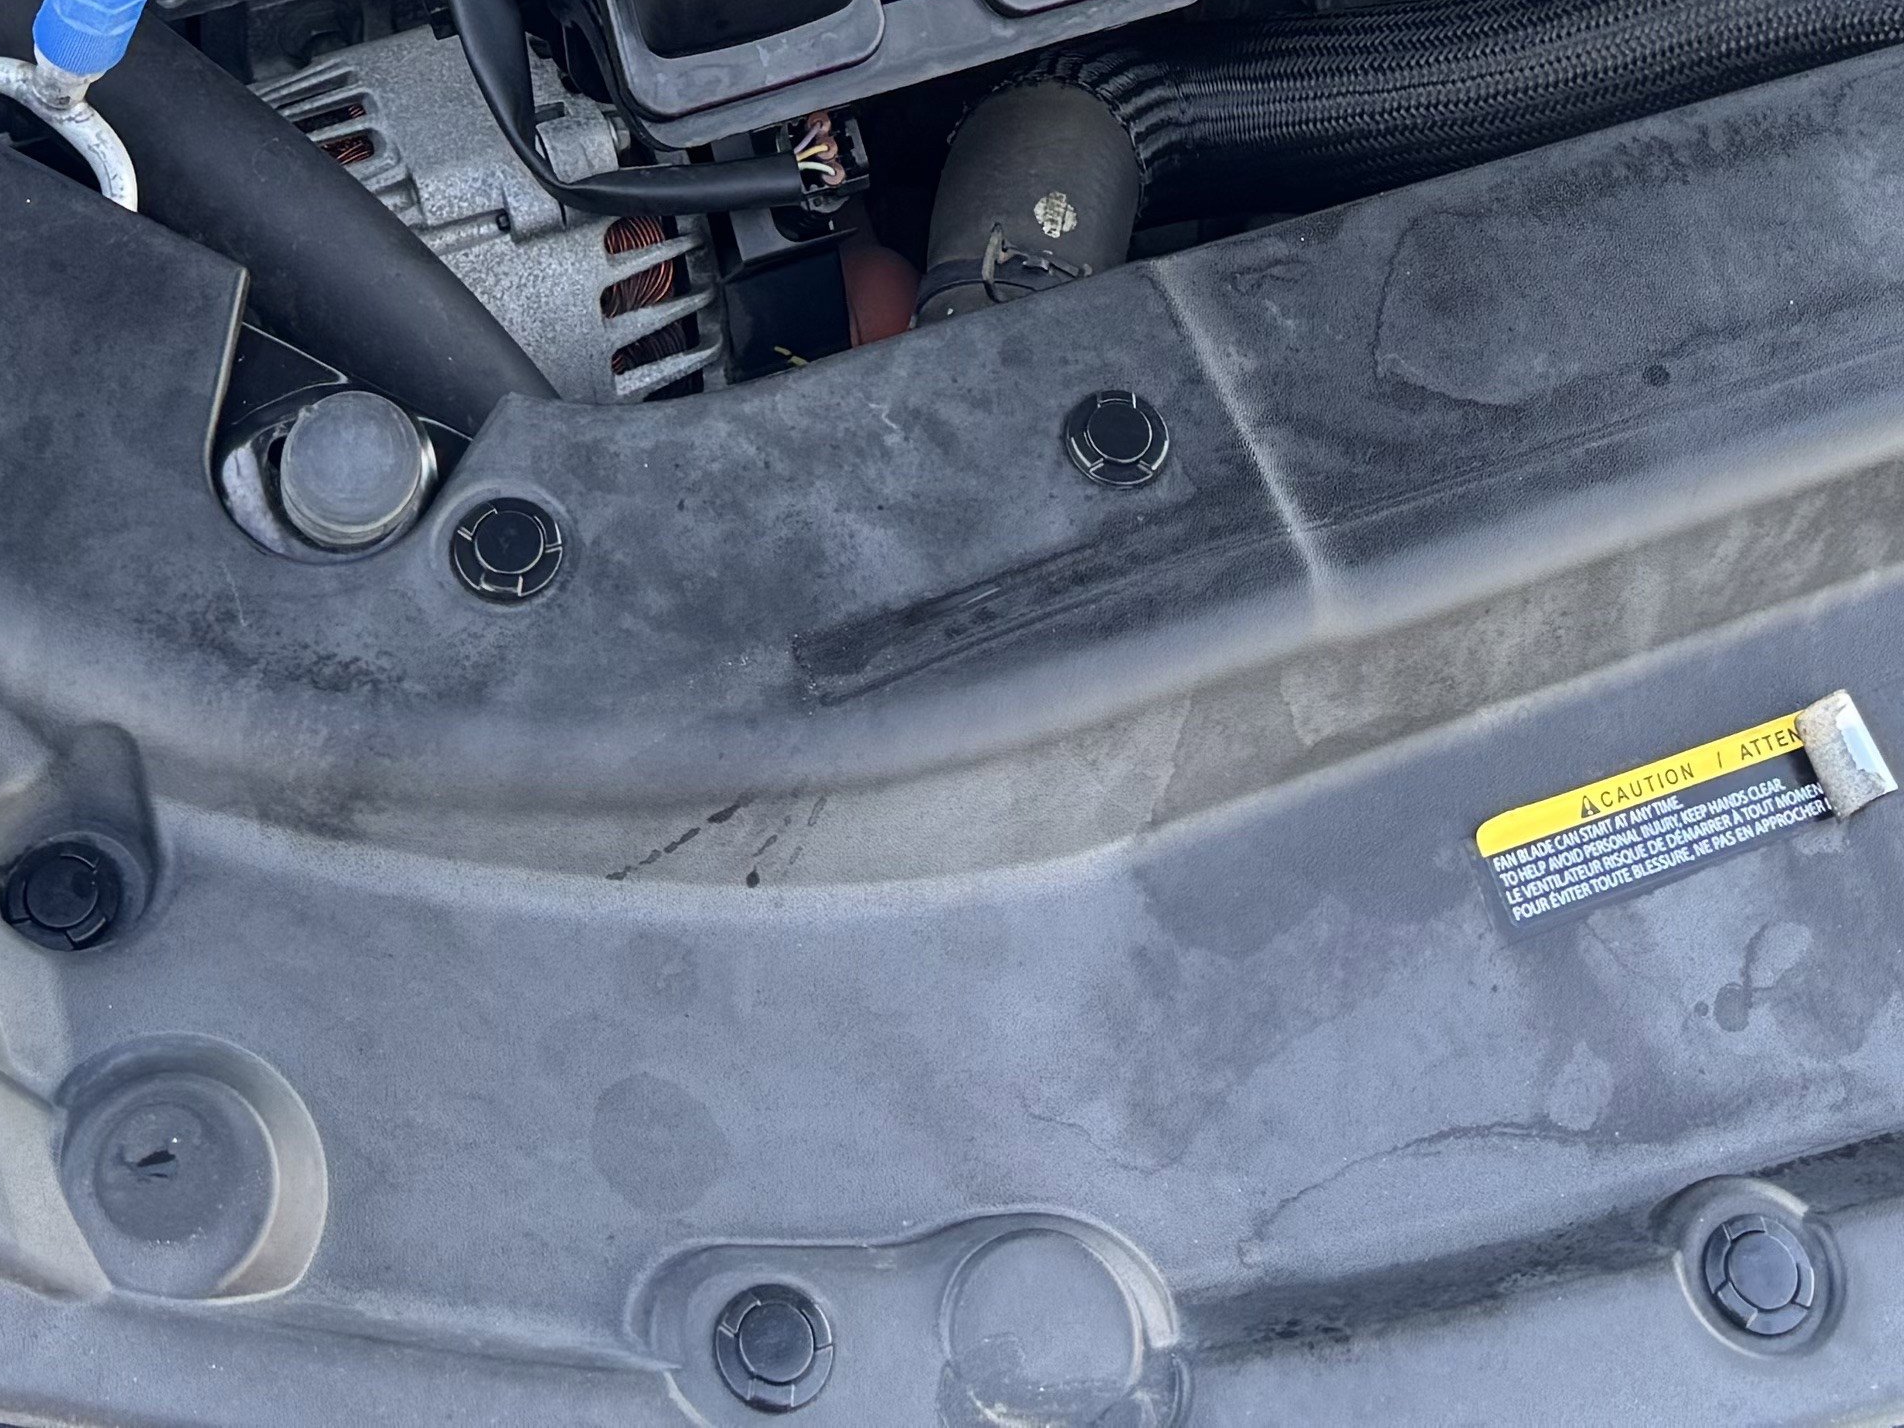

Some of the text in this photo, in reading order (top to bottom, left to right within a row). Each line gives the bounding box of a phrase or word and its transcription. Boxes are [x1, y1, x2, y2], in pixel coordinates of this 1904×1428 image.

[1600, 762, 1695, 808] CAUTION
[1493, 852, 1518, 872] FAN
[1517, 839, 1556, 866] BLADE
[1554, 831, 1582, 850] CAN
[1580, 818, 1615, 844] START
[1614, 812, 1629, 831] AT
[1630, 804, 1656, 826] ANY
[1499, 868, 1520, 888] TO
[1518, 860, 1547, 882] HELP
[1548, 847, 1585, 872] AVOID
[1583, 830, 1643, 860] PERSONAL
[1680, 804, 1708, 825] KEEP
[1707, 789, 1750, 815] HANDS
[1505, 888, 1523, 905] LE
[1521, 859, 1605, 898] VENTILATEUR
[1602, 844, 1649, 870] RISQUE
[1648, 837, 1669, 855] DE
[1666, 814, 1734, 850] DÉMARRER
[1741, 798, 1777, 821] TOUT
[1512, 896, 1551, 921] POUR
[1548, 882, 1591, 910] ÉVITER
[1590, 867, 1634, 893] TOUTE
[1694, 838, 1714, 857] NE
[1711, 832, 1738, 852] PAS
[1734, 824, 1757, 842] EN
[1754, 799, 1827, 837] APPROCHER
